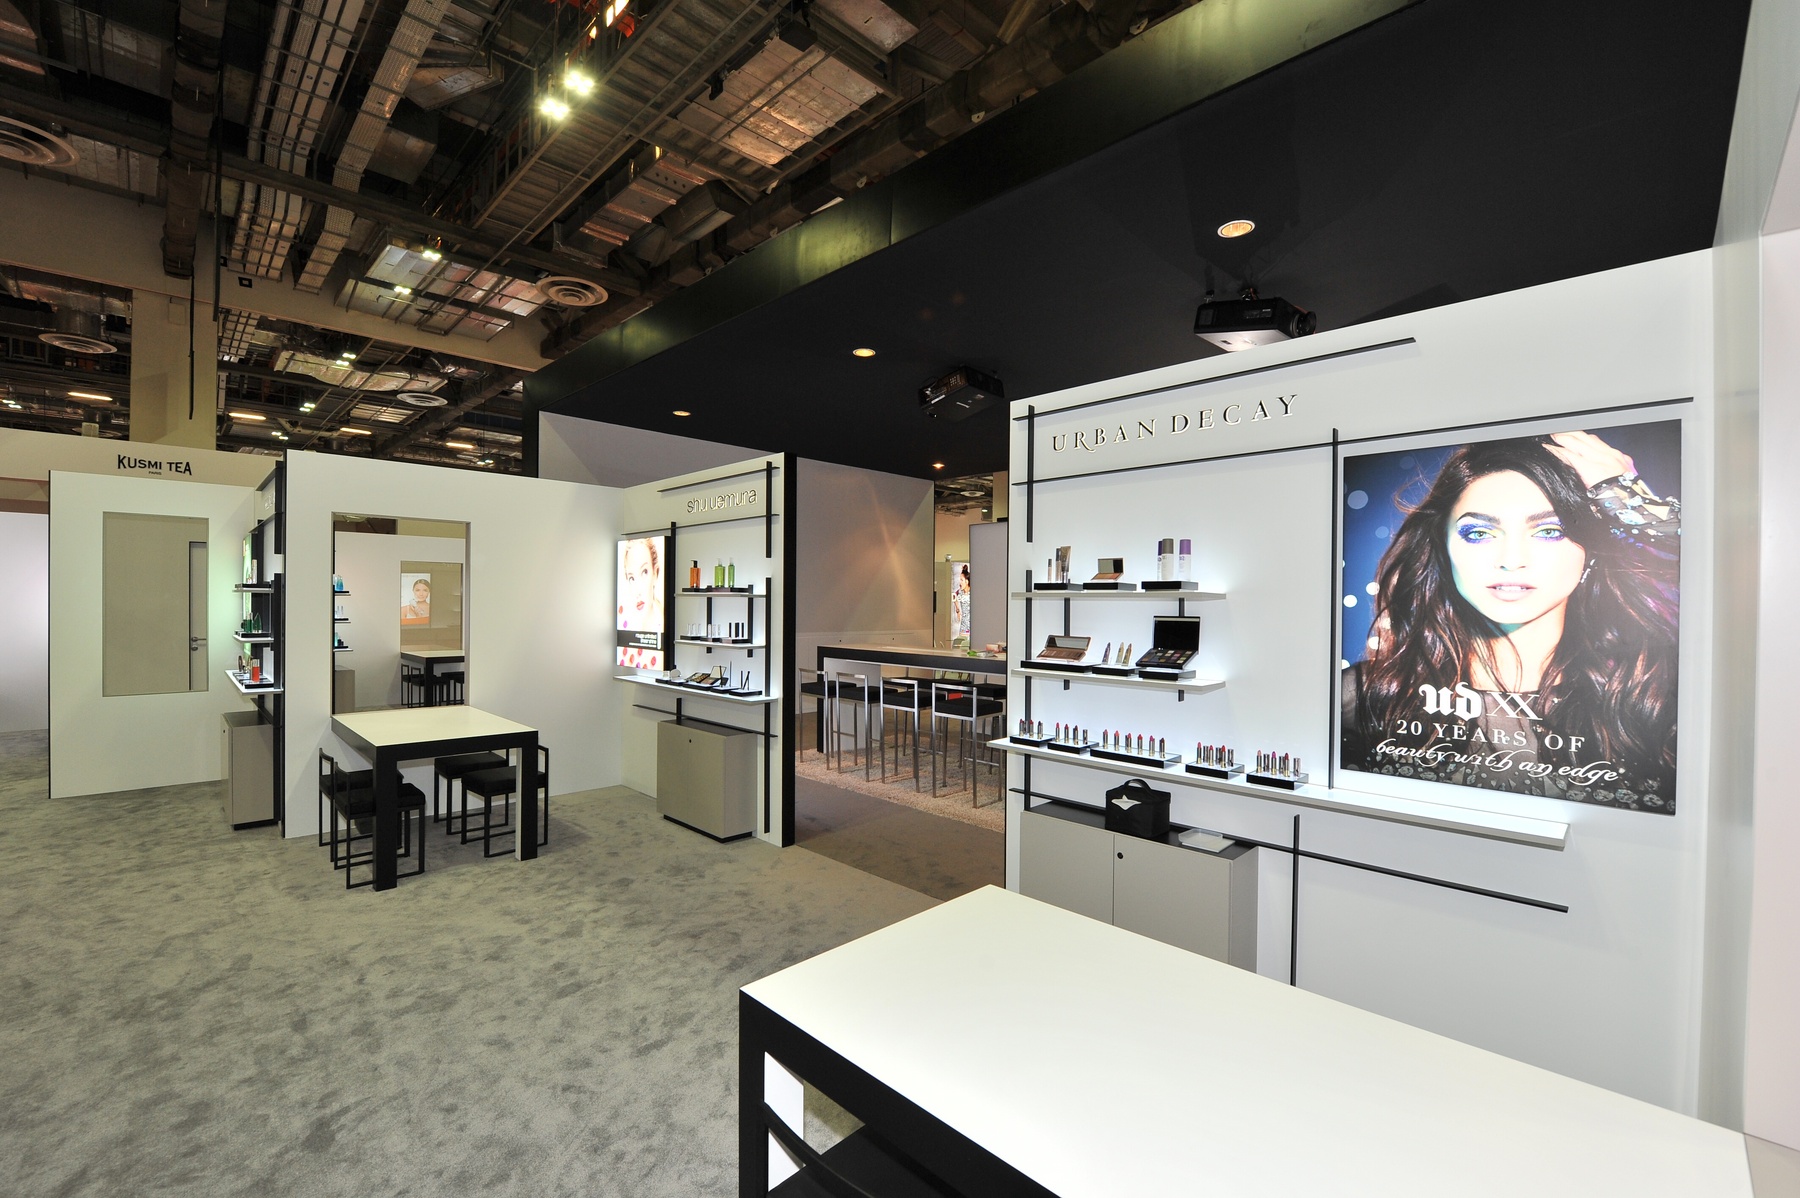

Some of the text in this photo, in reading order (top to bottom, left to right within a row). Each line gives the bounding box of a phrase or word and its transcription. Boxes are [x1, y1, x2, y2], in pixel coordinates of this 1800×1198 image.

[1052, 394, 1298, 453] URBAN DECAY
[117, 454, 193, 476] KUSMI TEA
[686, 489, 758, 514] shu uemura
[1396, 719, 1585, 752] 20 YEARS OF
[1375, 738, 1619, 786] beauty with an edge
